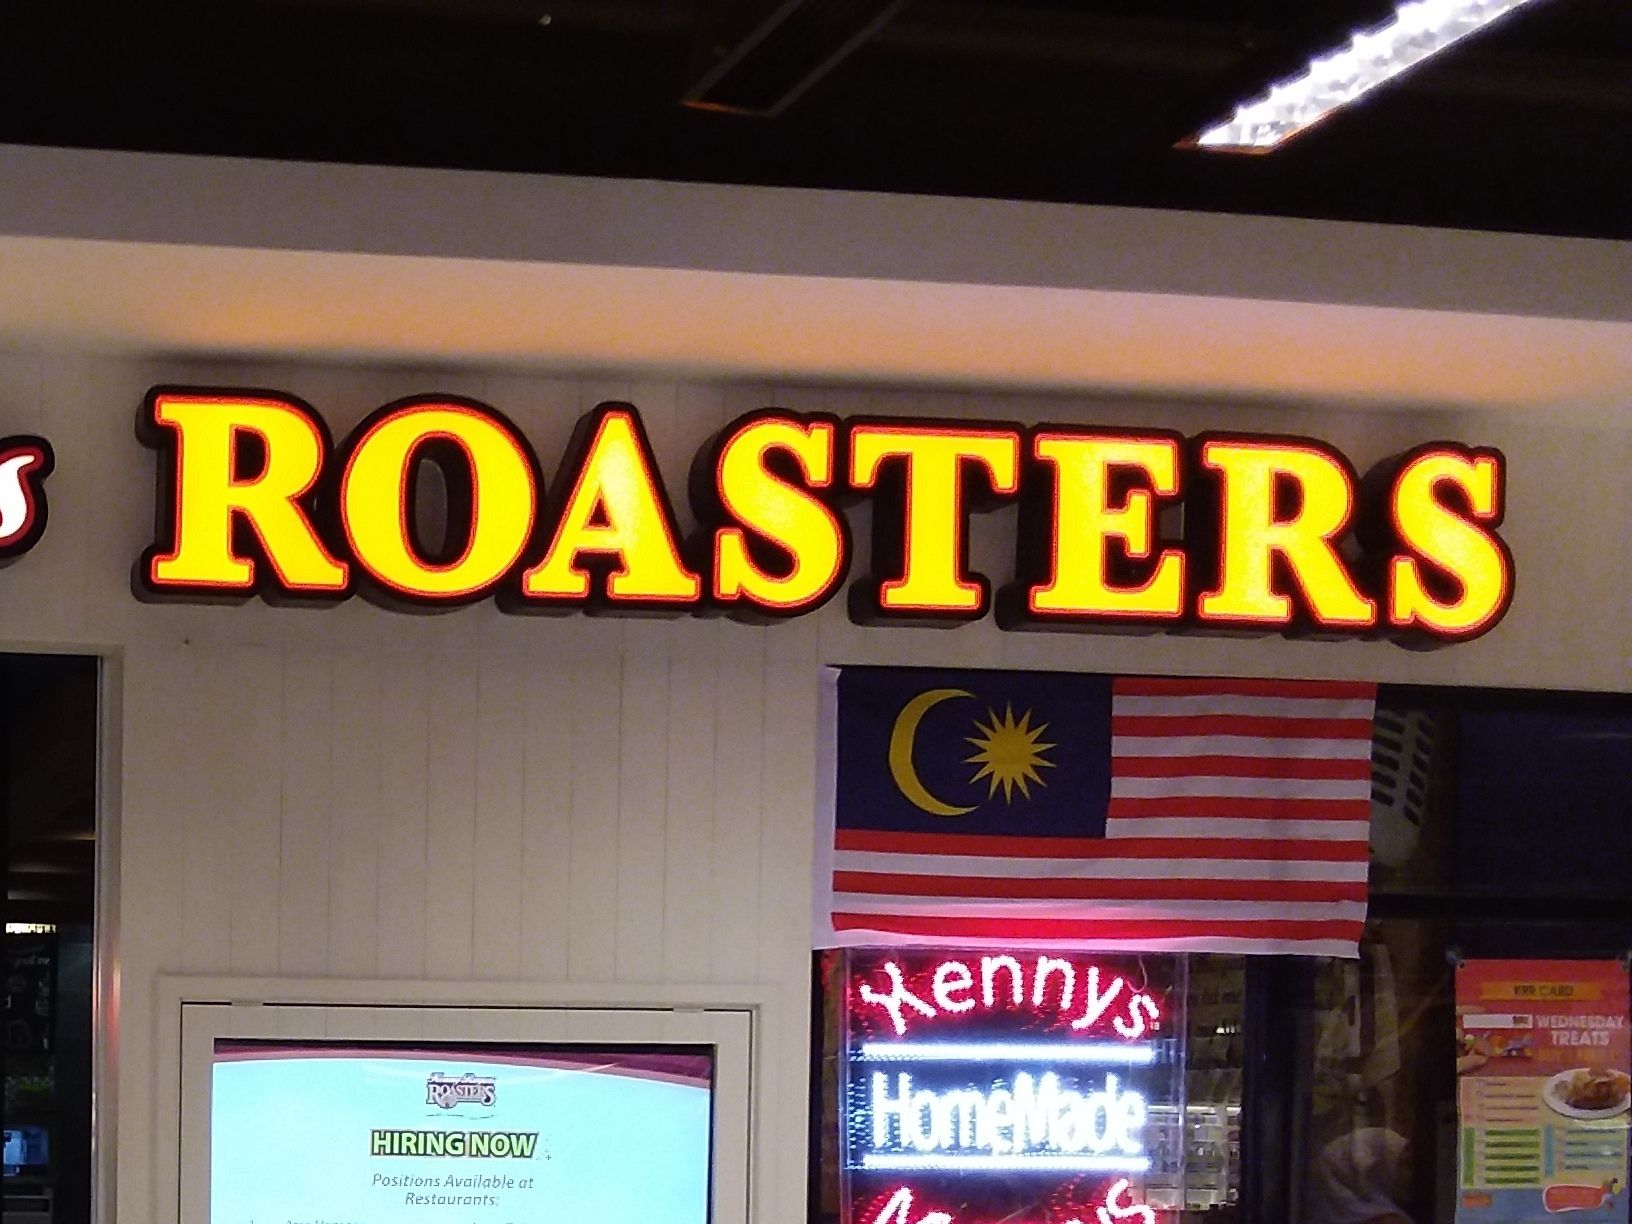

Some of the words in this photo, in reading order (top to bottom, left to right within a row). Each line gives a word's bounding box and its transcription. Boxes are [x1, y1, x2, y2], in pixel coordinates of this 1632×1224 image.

[148, 393, 1512, 637] ROASTERS
[1534, 1014, 1624, 1029] WEDNESDAY
[1551, 1030, 1611, 1046] TREATS
[371, 1130, 466, 1157] HIRING
[469, 1131, 539, 1159] NOW
[372, 1172, 441, 1188] Positions
[443, 1174, 515, 1190] Available
[518, 1176, 535, 1190] at
